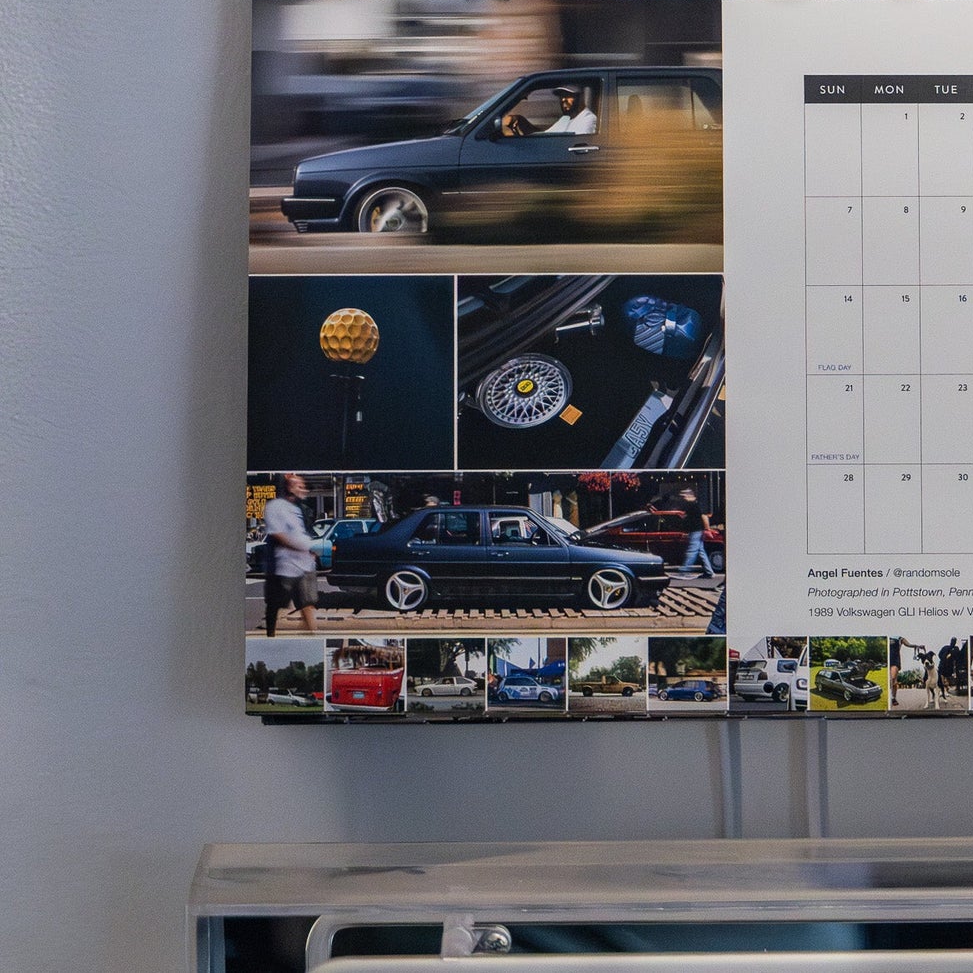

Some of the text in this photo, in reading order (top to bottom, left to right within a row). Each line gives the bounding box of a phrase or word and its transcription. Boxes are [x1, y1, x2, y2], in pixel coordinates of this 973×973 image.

[820, 85, 845, 95] SUN
[874, 85, 904, 95] MON
[934, 85, 958, 95] TUE
[844, 295, 853, 303] 14
[901, 294, 910, 303] 15
[958, 294, 968, 303] 16
[845, 384, 853, 392] 21
[900, 383, 911, 392] 22
[958, 383, 968, 392] 23
[843, 473, 969, 482] 28 29 30
[807, 568, 838, 580] Angel
[841, 568, 884, 578] Fuentes
[893, 567, 960, 578] @randomsole
[807, 587, 879, 599] Photographed
[880, 587, 890, 597] in
[892, 587, 945, 598] Pottstown,
[808, 607, 834, 617] 1989
[836, 607, 895, 619] Volkswagen
[898, 607, 915, 617] GLI
[918, 607, 949, 617] Helios
[951, 607, 964, 616] w/
